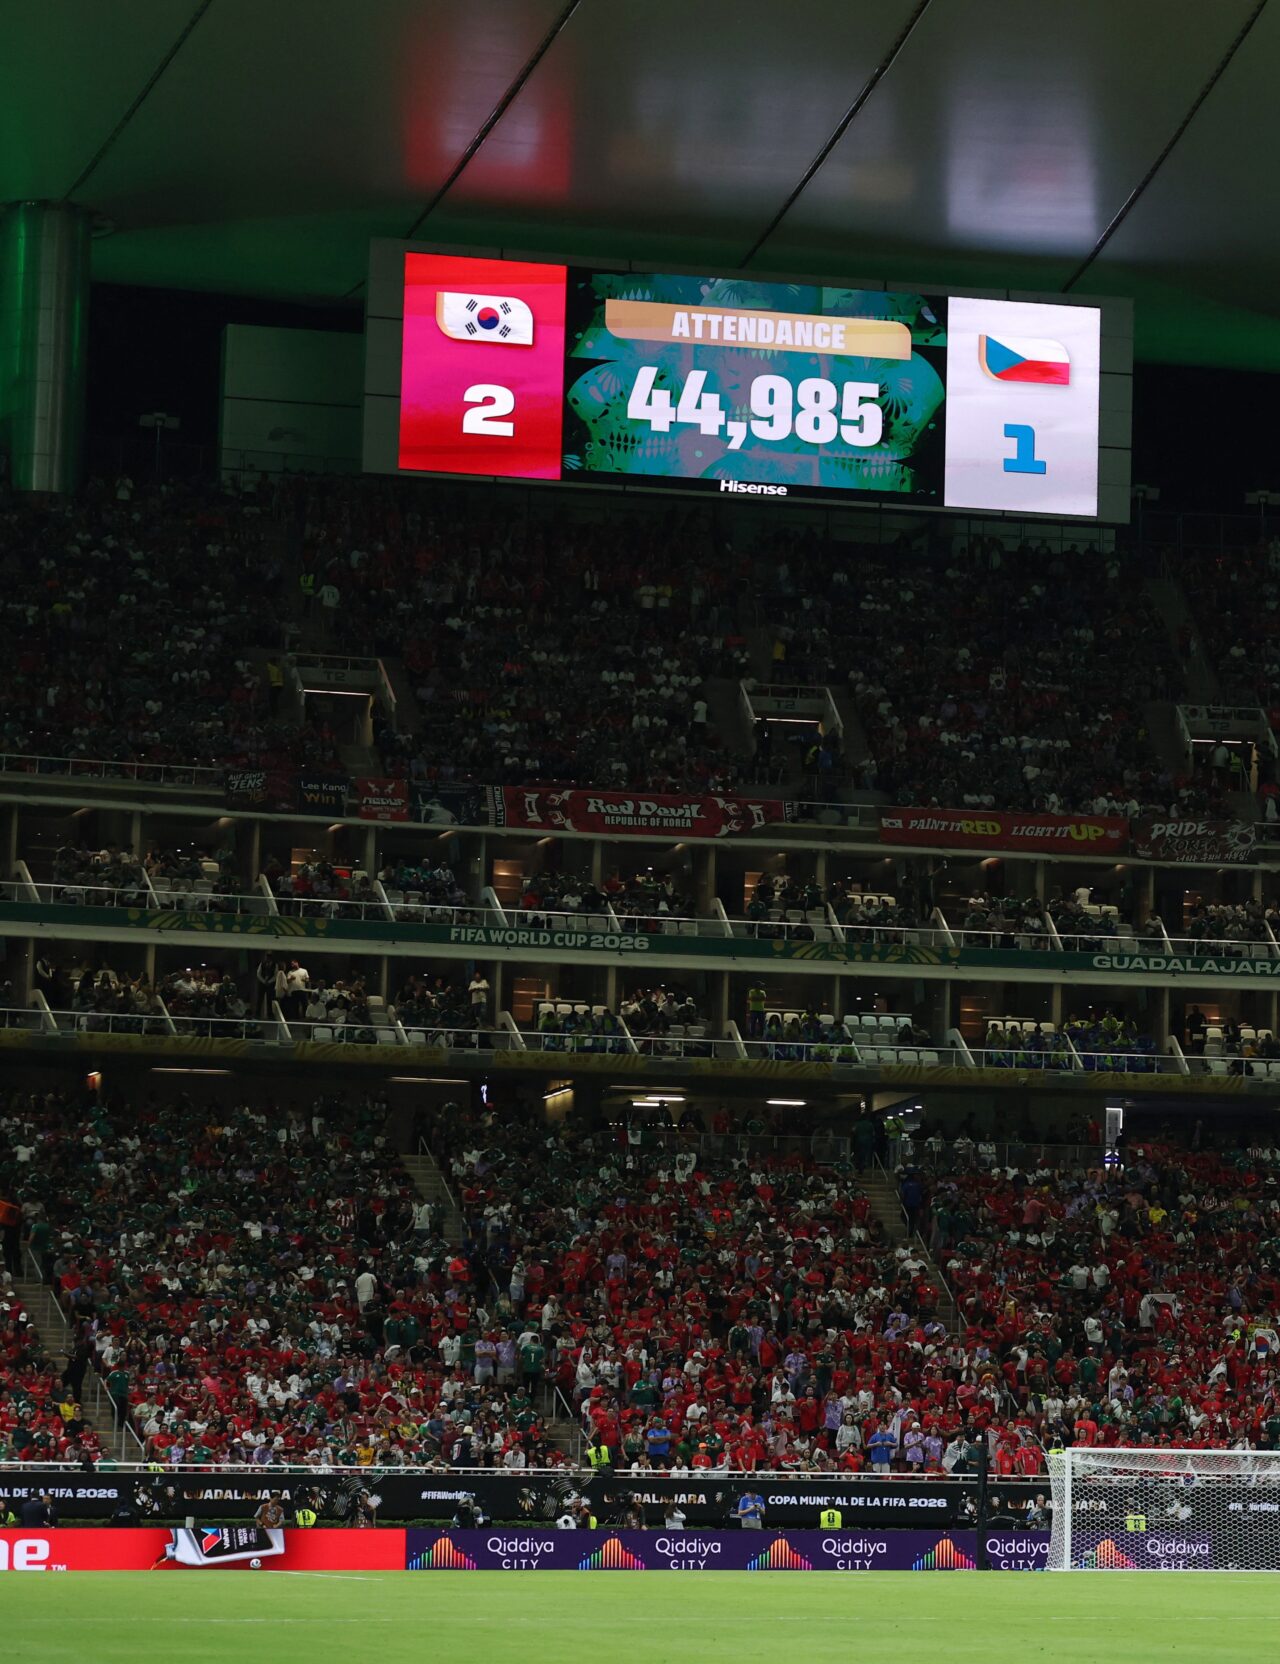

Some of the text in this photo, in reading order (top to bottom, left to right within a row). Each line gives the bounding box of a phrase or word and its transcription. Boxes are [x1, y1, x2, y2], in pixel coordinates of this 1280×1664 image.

[671, 310, 846, 350] ATTENDANCE
[462, 383, 515, 438] 2
[627, 366, 883, 450] 44,985
[1003, 423, 1047, 475] 1
[720, 478, 788, 497] Hisense
[323, 672, 345, 682] T2
[773, 699, 795, 709] T2
[1210, 721, 1231, 731] T2
[229, 779, 263, 791] JENS
[301, 781, 347, 793] Lee Kang
[303, 792, 336, 804] Win
[587, 798, 635, 815] Red
[604, 815, 692, 828] REPUBLIC OF KOREA
[908, 817, 949, 831] PAINT
[960, 819, 1002, 835] RED
[1011, 825, 1055, 837] LIGHT
[1070, 824, 1105, 841] UP
[1151, 821, 1209, 840] PRIDE
[450, 928, 650, 950] FIFA WORLD CUP 2026
[12, 1488, 29, 1498] DE
[48, 1488, 74, 1499] FIFA
[76, 1489, 119, 1500] 2026
[768, 1496, 798, 1506] COPA
[851, 1497, 865, 1507] DE
[866, 1497, 880, 1507] LA
[882, 1497, 906, 1508] FIFA
[908, 1498, 948, 1508] 2026
[487, 1536, 555, 1557] Qiddiya
[655, 1537, 721, 1558] Qiddiya
[822, 1538, 887, 1558] Qiddiya
[986, 1538, 1050, 1558] Qiddiya
[1146, 1539, 1210, 1558] Qiddiya
[502, 1559, 539, 1570] CITY
[670, 1559, 706, 1570] CITY
[836, 1559, 872, 1570] CITY
[1000, 1560, 1035, 1570] CITY
[1161, 1560, 1185, 1570] CIT
